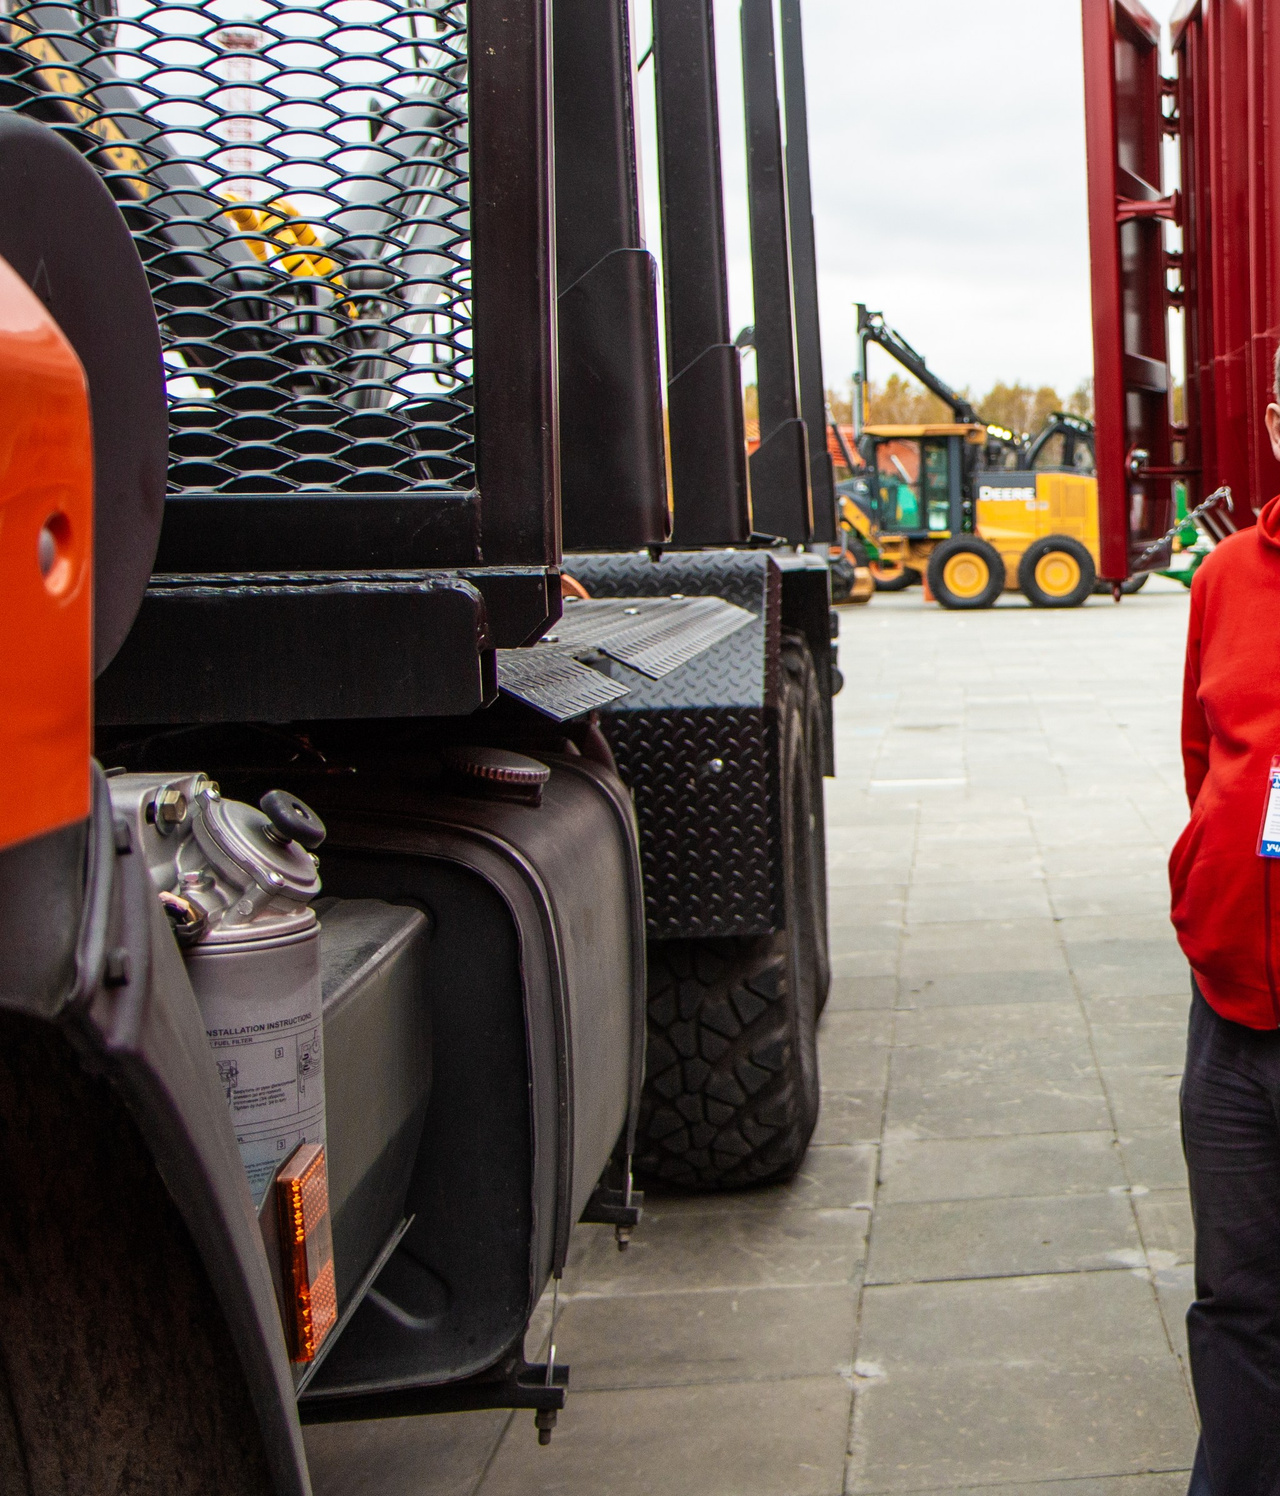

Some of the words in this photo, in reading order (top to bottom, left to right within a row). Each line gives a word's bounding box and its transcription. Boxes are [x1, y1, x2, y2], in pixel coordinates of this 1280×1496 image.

[979, 485, 1035, 502] DEERE
[206, 1023, 265, 1037] NSTALLATION
[267, 1011, 312, 1030] INSTRUCTIONS
[213, 1039, 230, 1047] FUEL
[231, 1037, 253, 1045] FILTER
